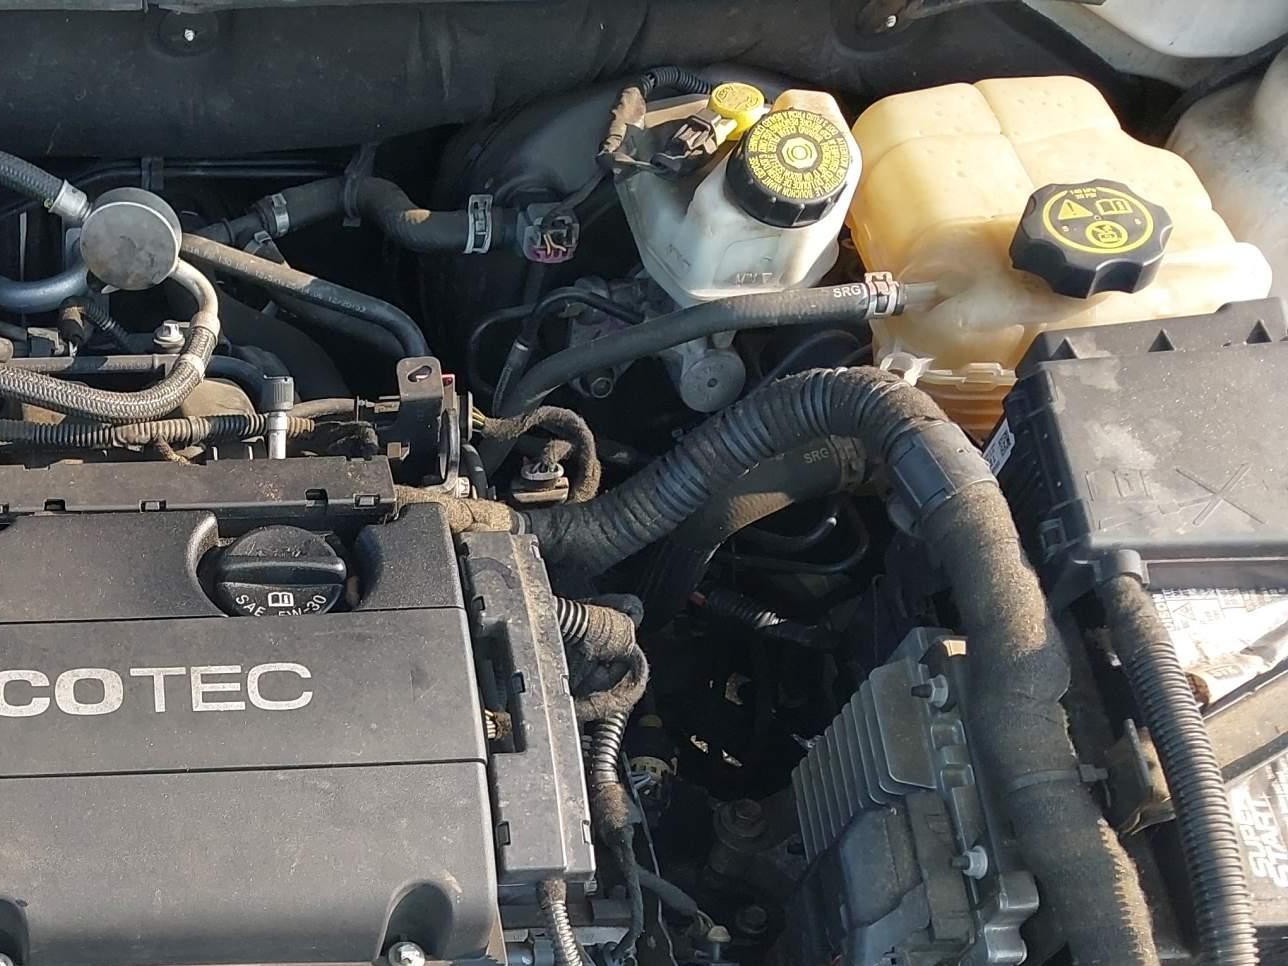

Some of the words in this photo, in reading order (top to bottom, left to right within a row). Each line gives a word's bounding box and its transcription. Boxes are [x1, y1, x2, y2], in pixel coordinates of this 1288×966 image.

[833, 285, 861, 298] SRG
[802, 448, 830, 464] SRG
[235, 594, 266, 616] SAE
